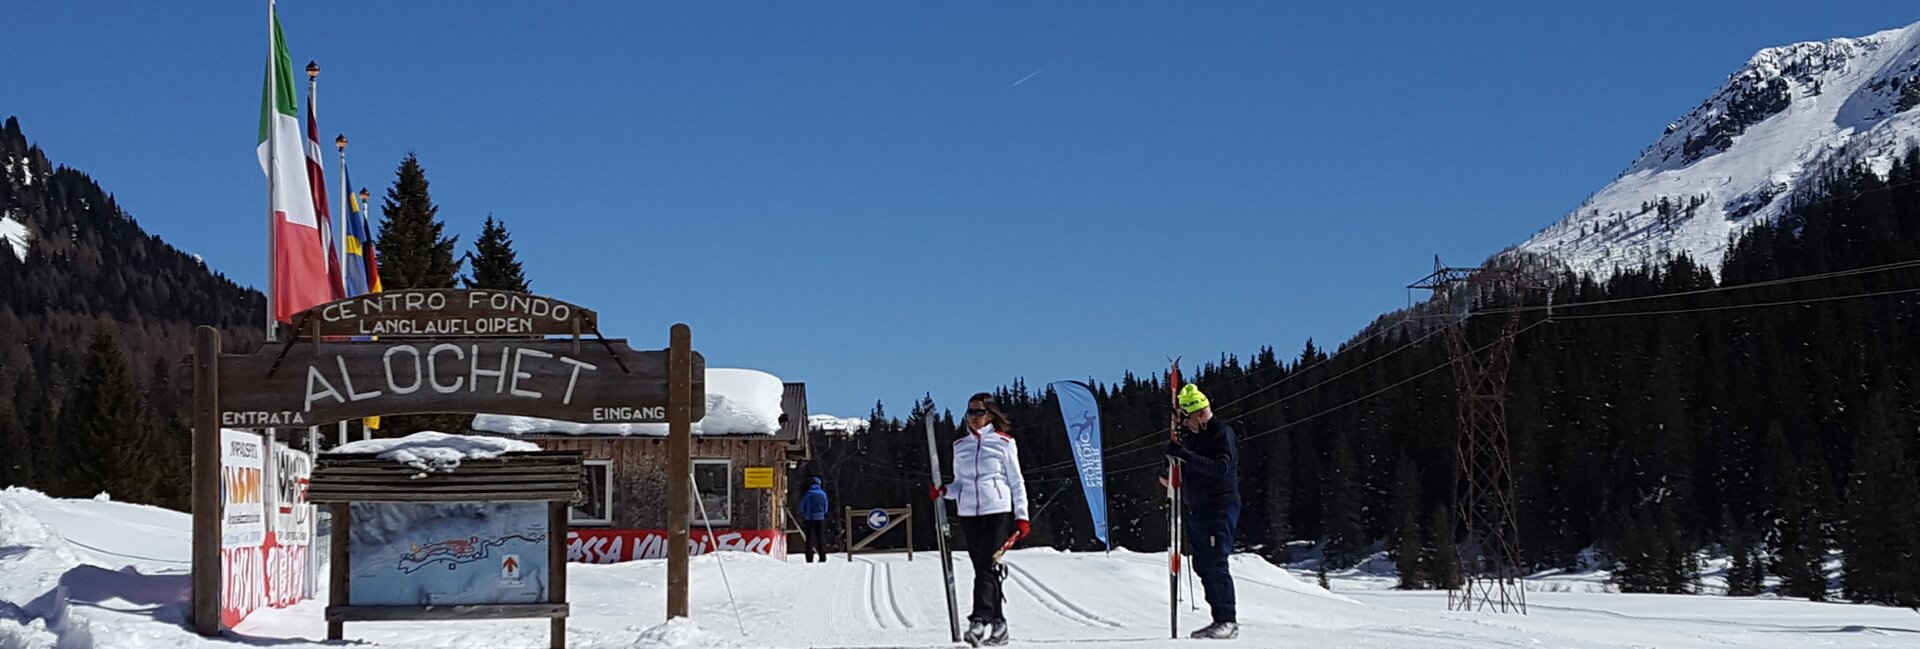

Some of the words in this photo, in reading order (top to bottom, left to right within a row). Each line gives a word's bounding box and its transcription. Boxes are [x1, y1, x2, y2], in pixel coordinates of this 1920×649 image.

[322, 292, 447, 323] CENTRO
[469, 292, 570, 321] FONDO
[359, 317, 533, 334] LANGLAUFLOIPEN
[304, 343, 598, 412] ALOCHET
[222, 411, 304, 425] ENTRATA
[593, 406, 665, 421] EINGANG
